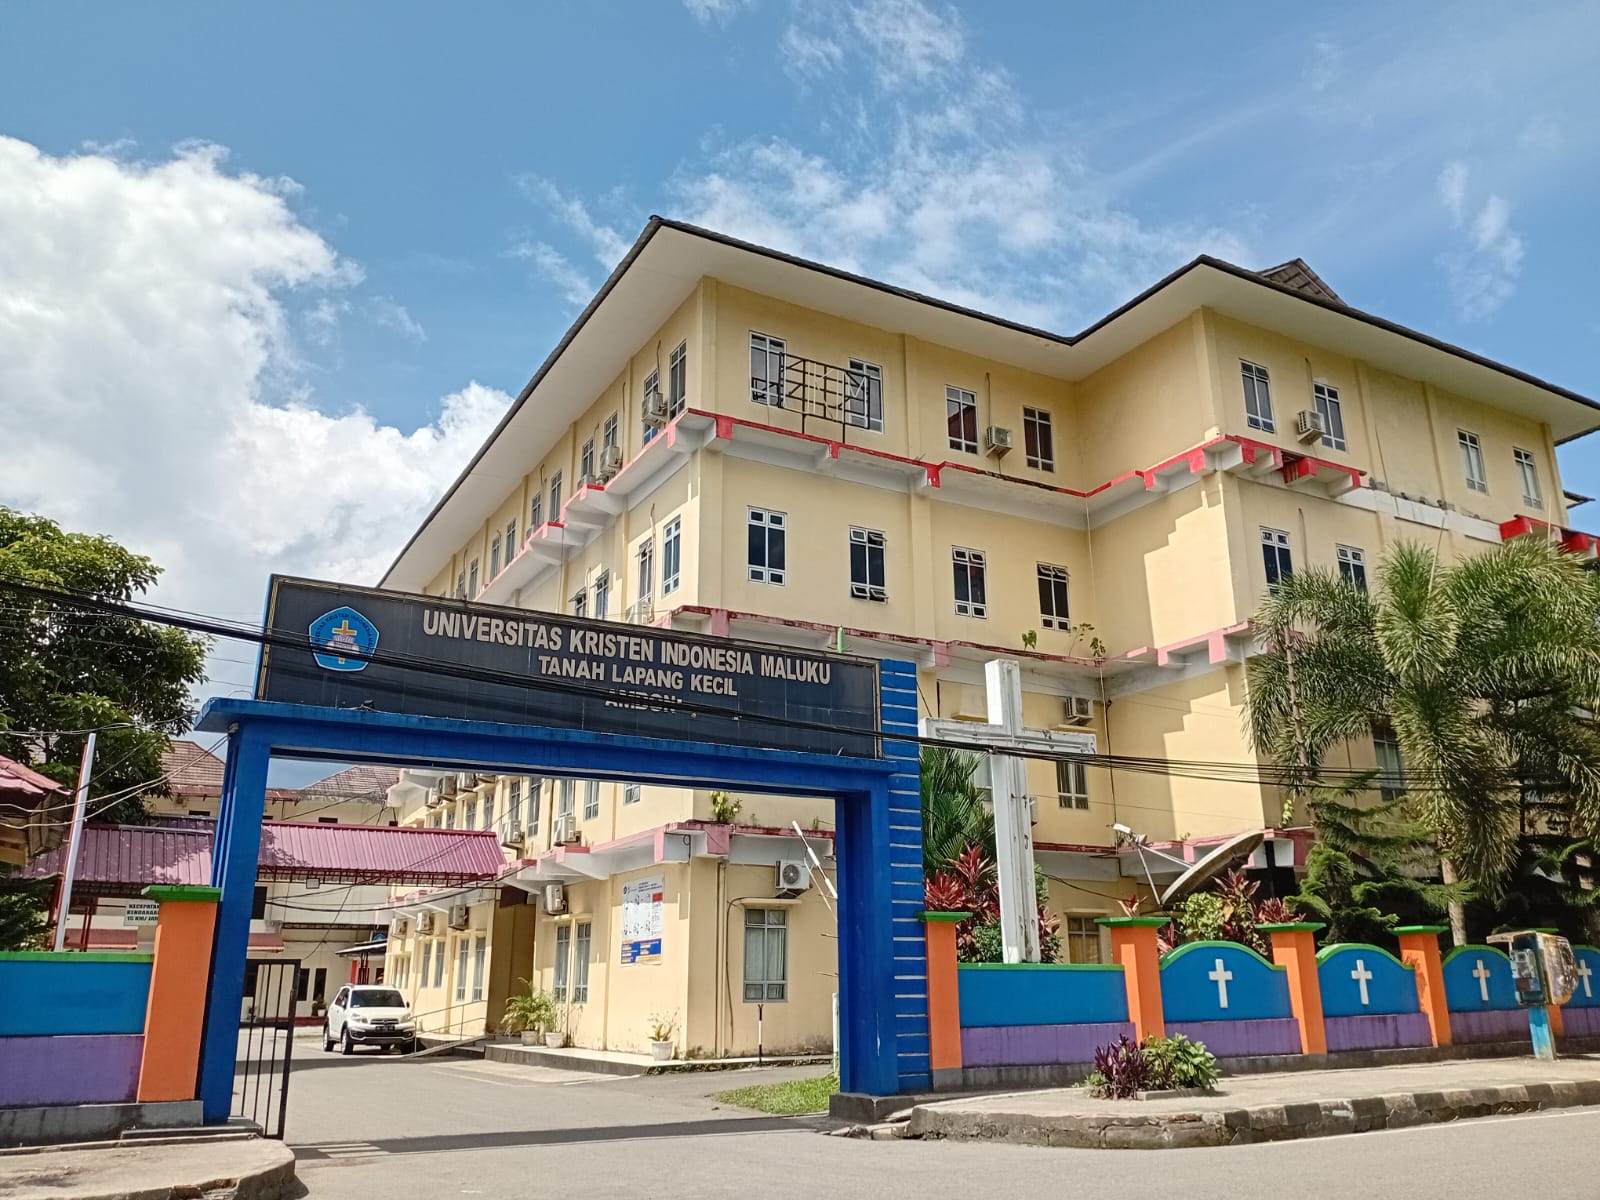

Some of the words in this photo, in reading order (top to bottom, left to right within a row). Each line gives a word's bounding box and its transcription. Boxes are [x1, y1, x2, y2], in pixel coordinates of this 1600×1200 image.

[423, 609, 562, 651] UNIVERSITAS
[569, 629, 654, 662] KRISTEN
[661, 641, 754, 675] INDONESIA
[760, 654, 831, 685] MALUKU
[538, 655, 605, 681] TANAH
[612, 664, 684, 690] LAPANG
[690, 673, 738, 696] KECIL
